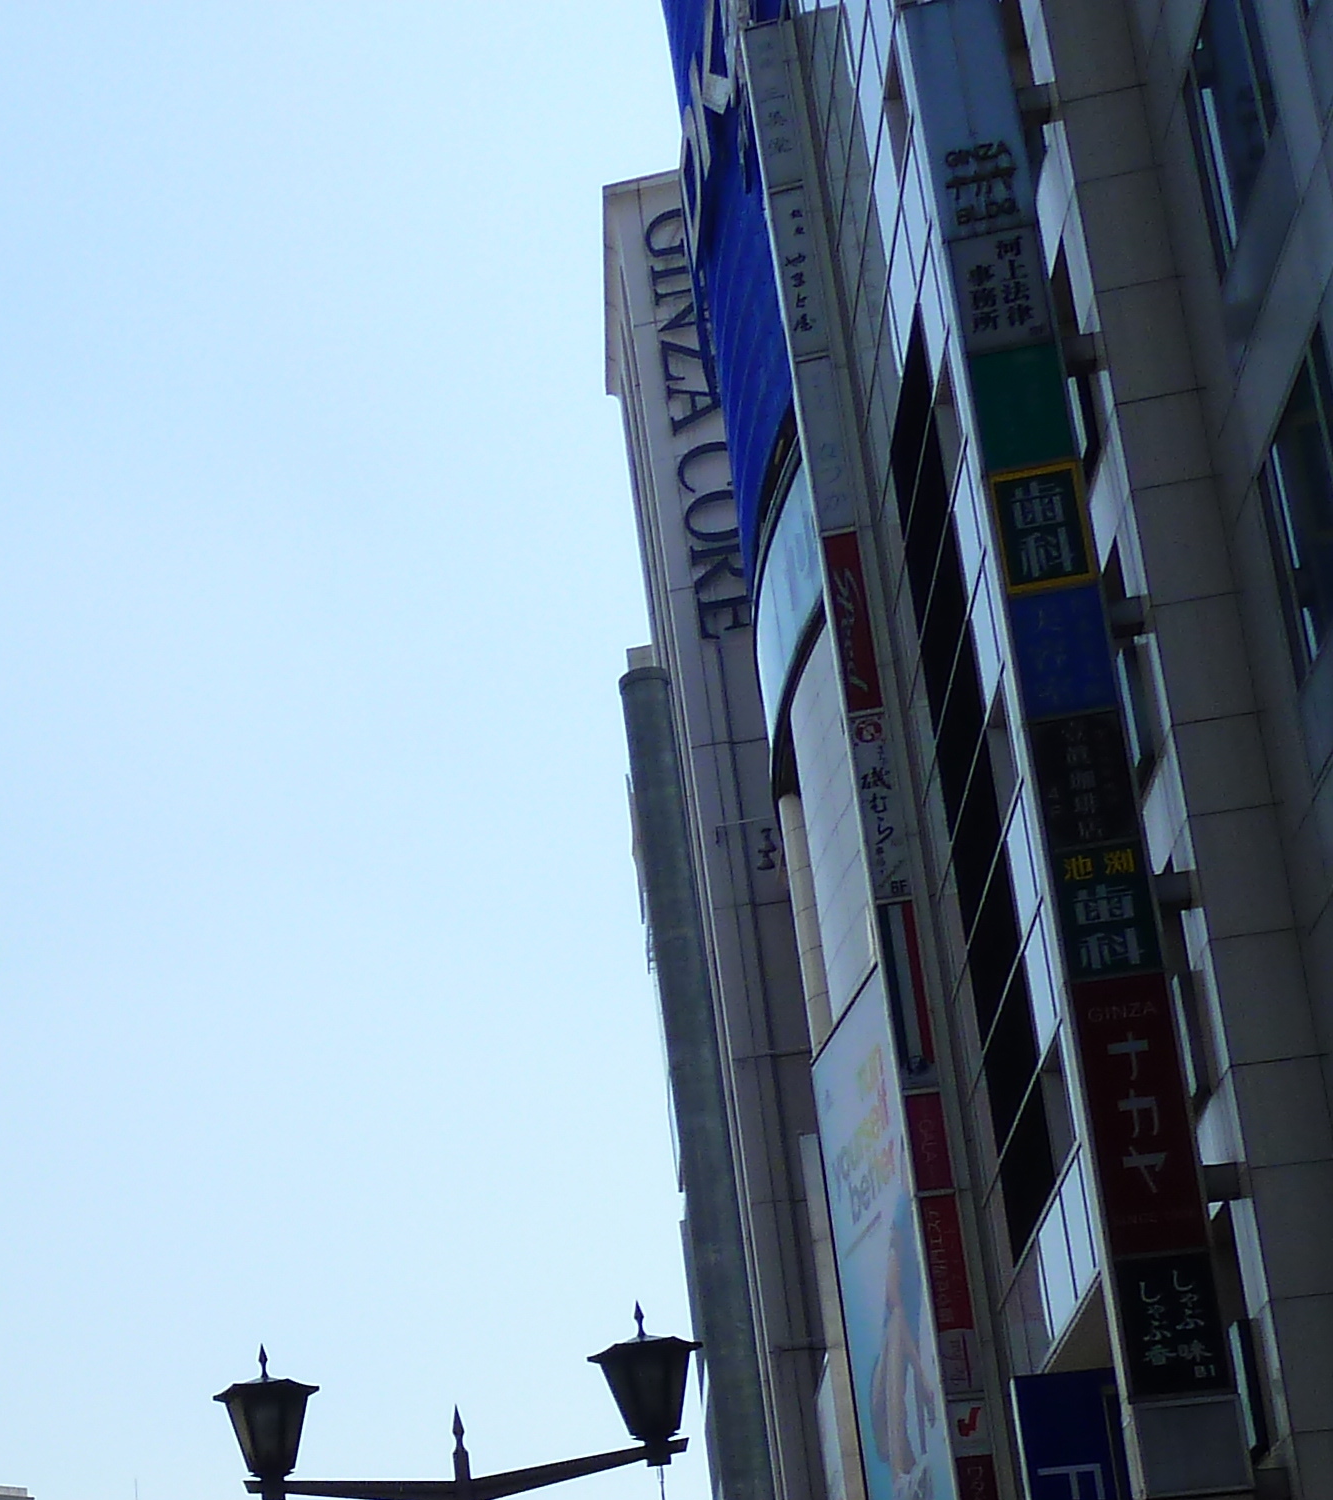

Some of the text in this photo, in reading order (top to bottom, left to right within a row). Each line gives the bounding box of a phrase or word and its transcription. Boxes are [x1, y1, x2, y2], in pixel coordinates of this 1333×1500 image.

[1012, 481, 1074, 579] 歯科
[1073, 884, 1144, 970] 歯科
[1107, 1031, 1168, 1195] ナカヤ
